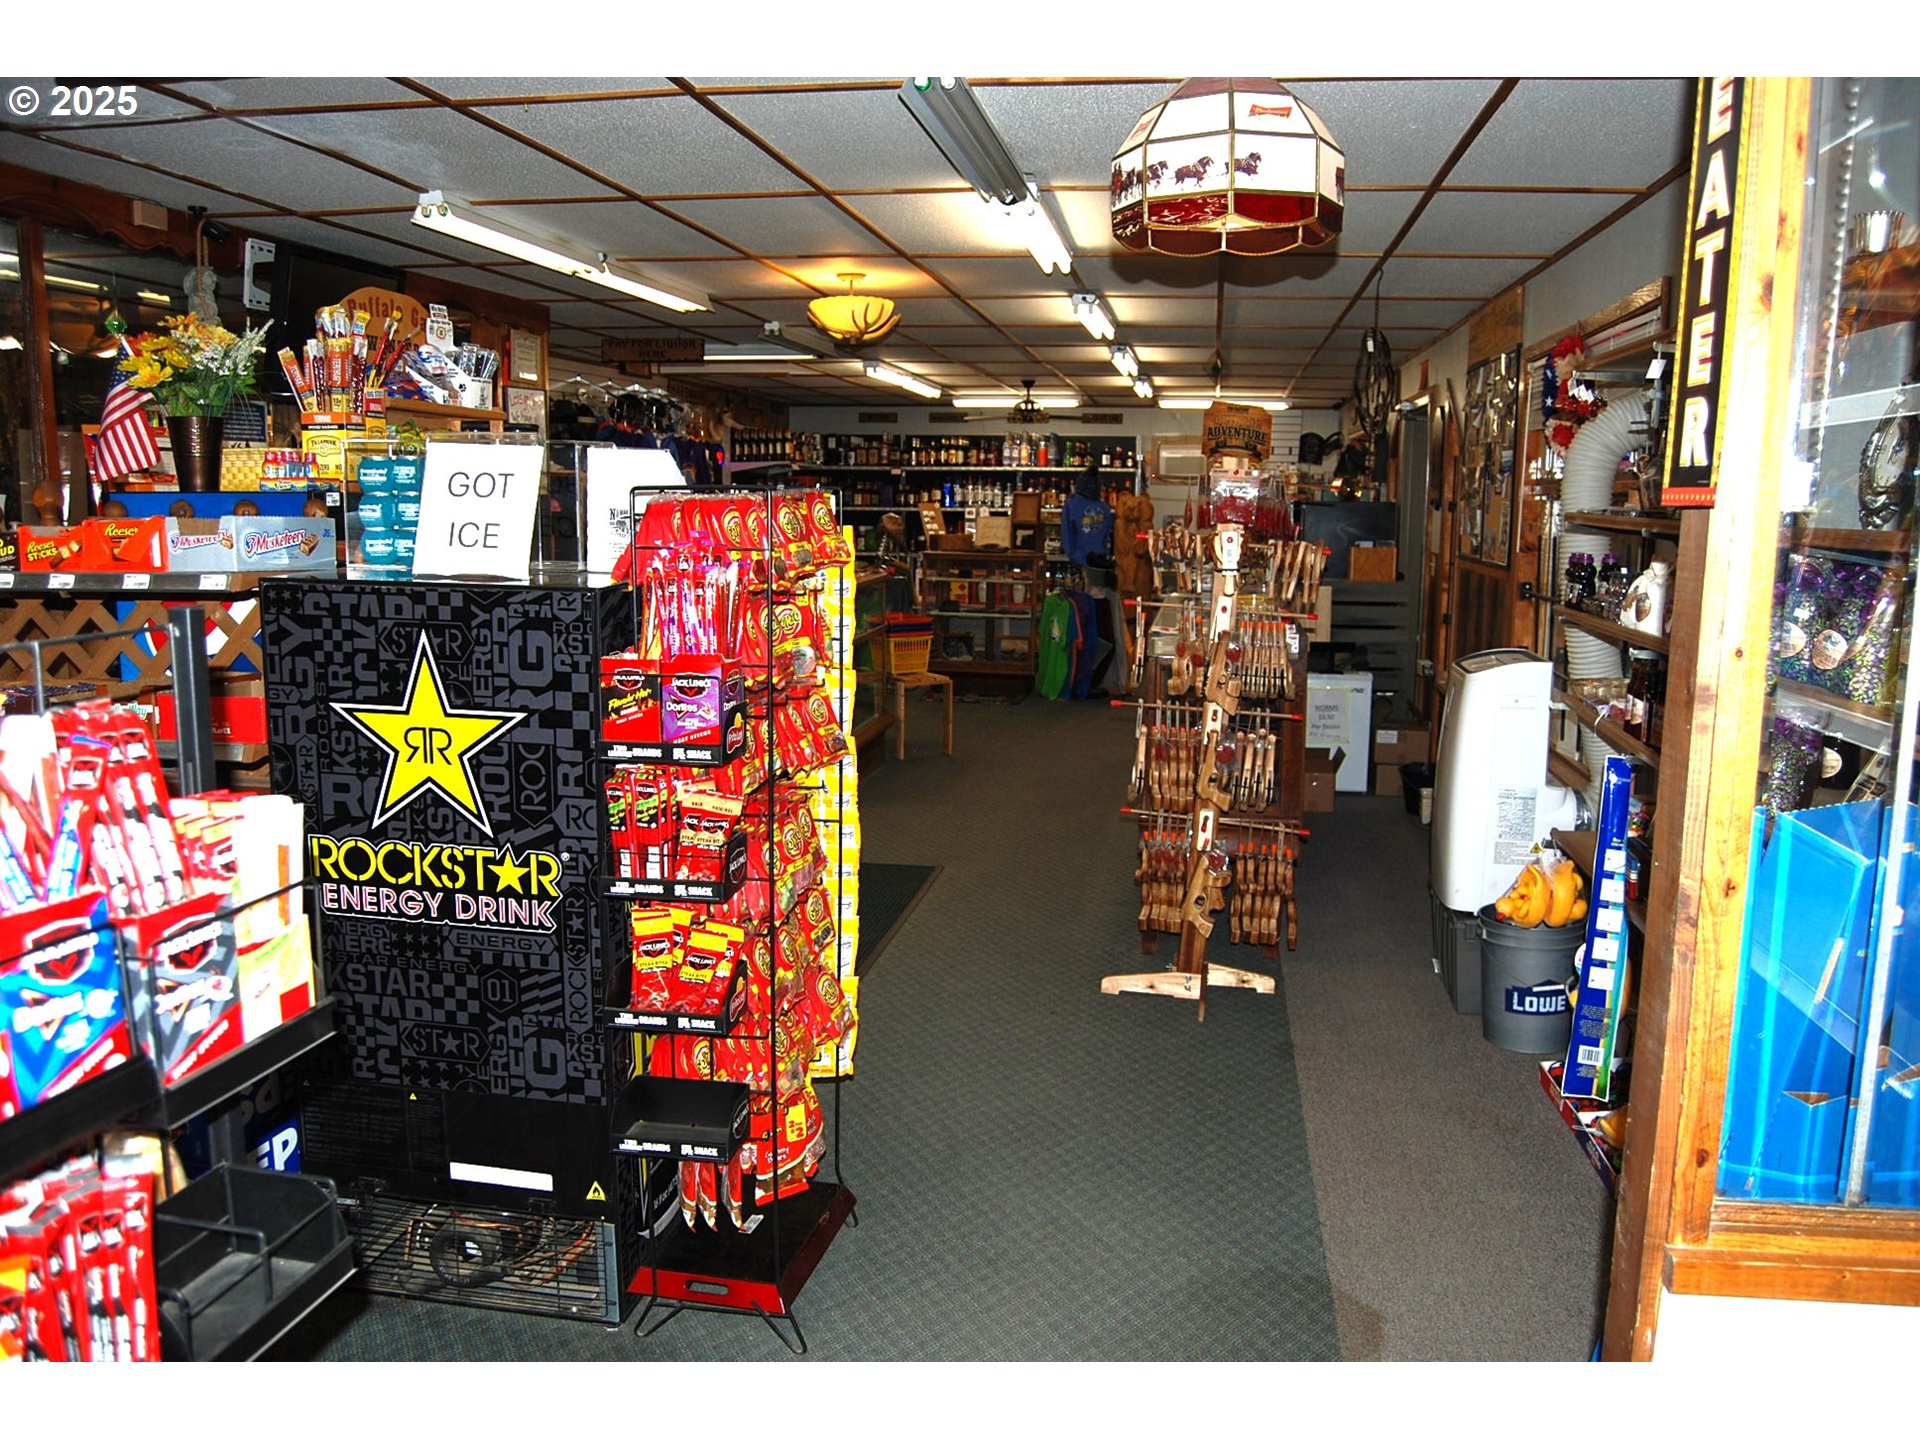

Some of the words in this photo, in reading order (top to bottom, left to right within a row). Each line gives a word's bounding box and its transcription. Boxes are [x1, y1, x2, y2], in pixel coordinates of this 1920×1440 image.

[1207, 426, 1268, 443] ADVENTURE
[448, 471, 515, 498] GOT
[256, 530, 305, 552] Musketeers
[449, 521, 501, 549] ICE
[666, 700, 698, 713] Doritos
[311, 837, 559, 898] ROCKSTAR
[322, 882, 444, 918] ENERGY
[455, 893, 553, 928] DRINK
[456, 932, 547, 951] ENERGY
